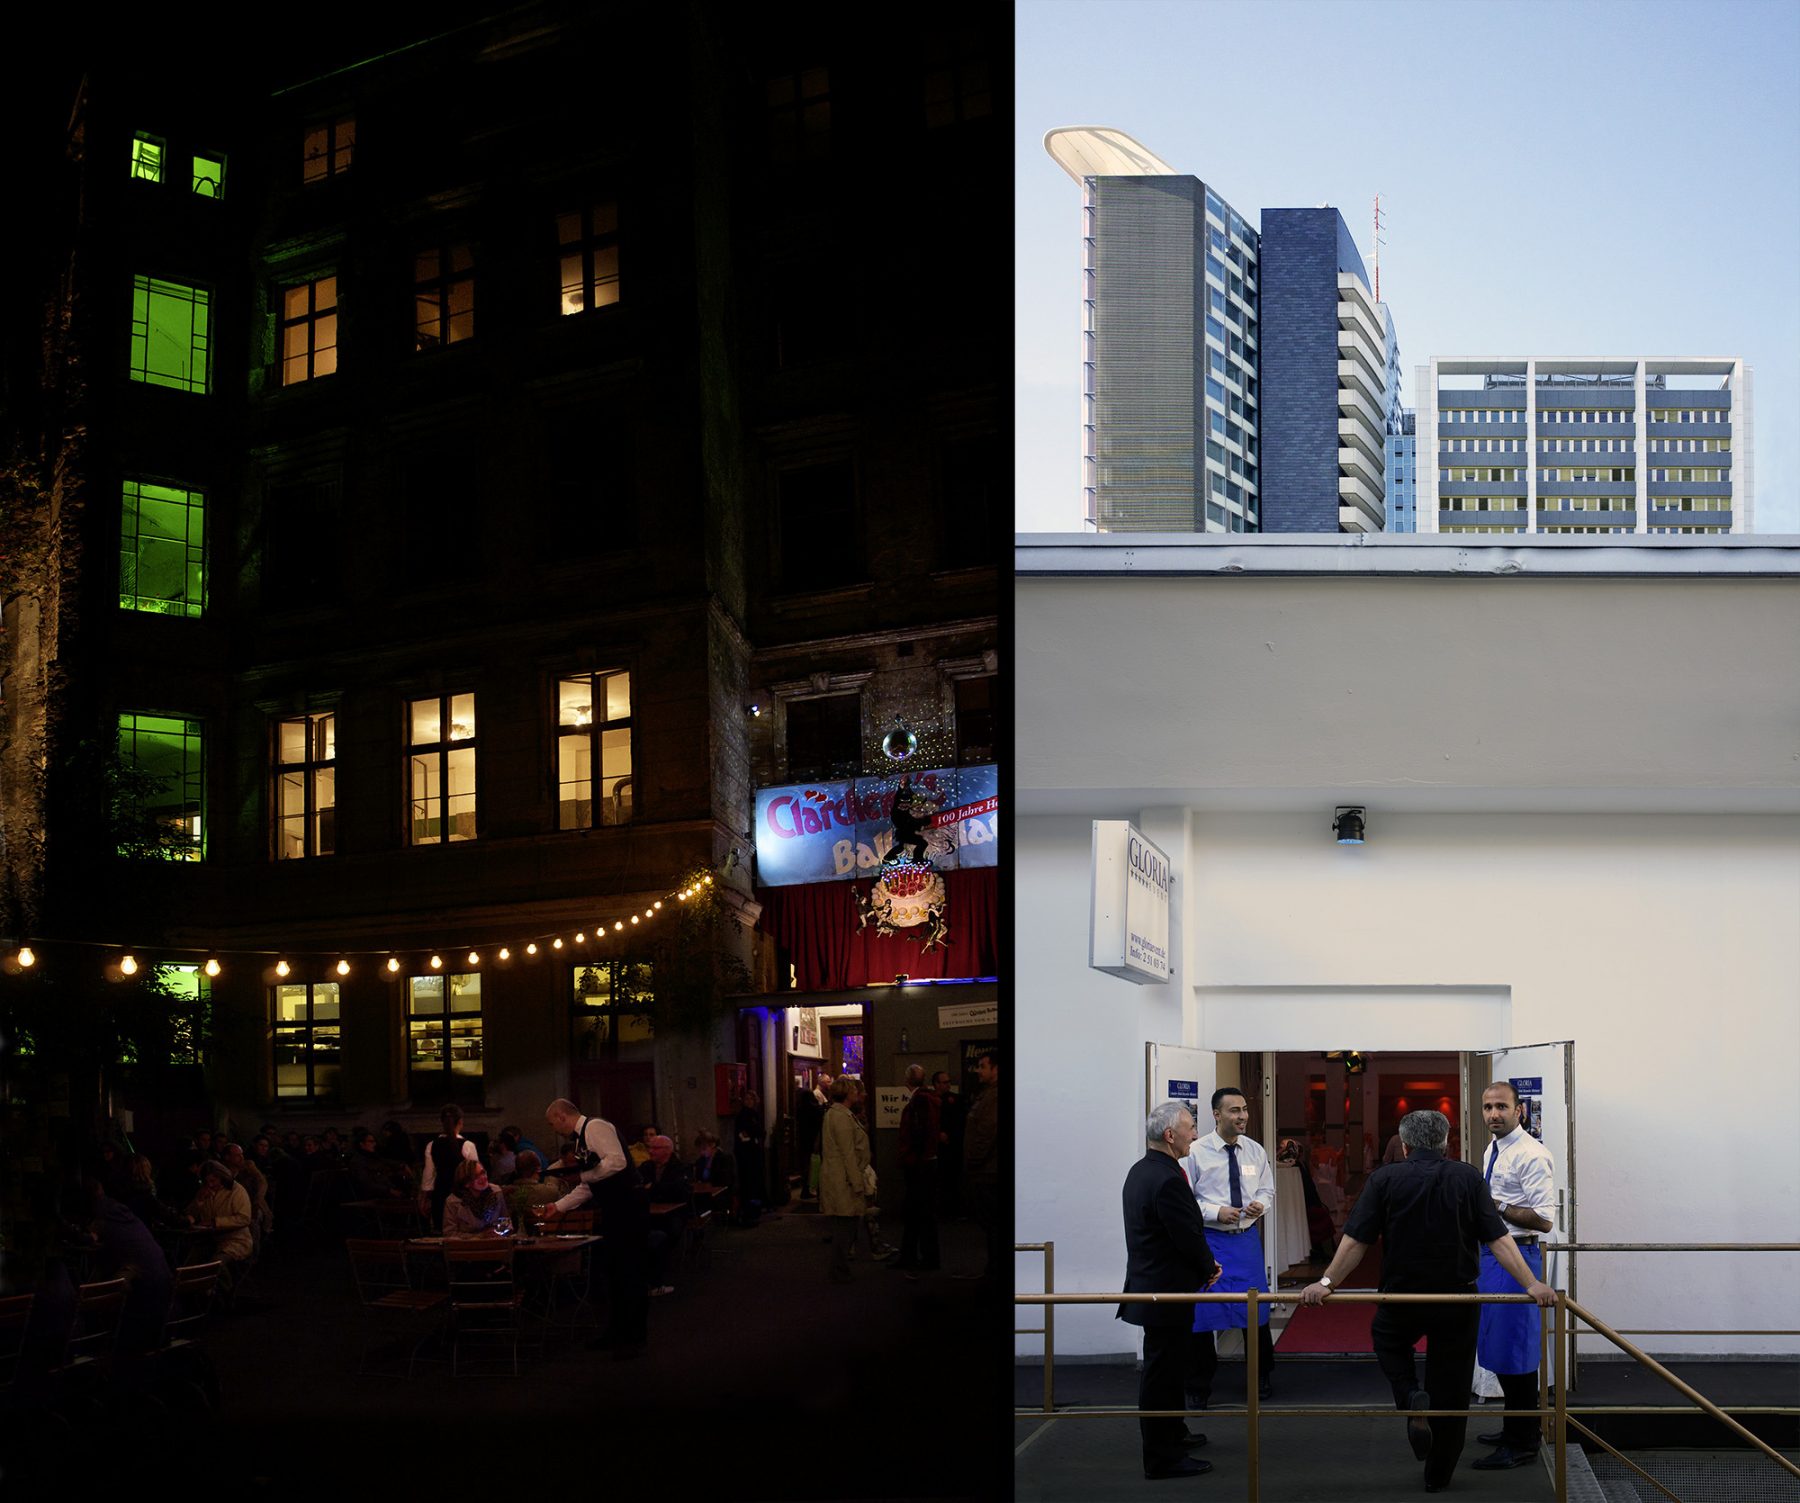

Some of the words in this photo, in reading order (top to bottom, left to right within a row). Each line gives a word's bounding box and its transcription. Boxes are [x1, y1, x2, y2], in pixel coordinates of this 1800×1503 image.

[937, 811, 955, 825] 100
[958, 805, 984, 821] Jahre
[1130, 838, 1168, 892] GLORIA
[1130, 945, 1142, 960] Info:
[881, 1094, 899, 1102] Wir
[883, 1105, 899, 1114] Sie
